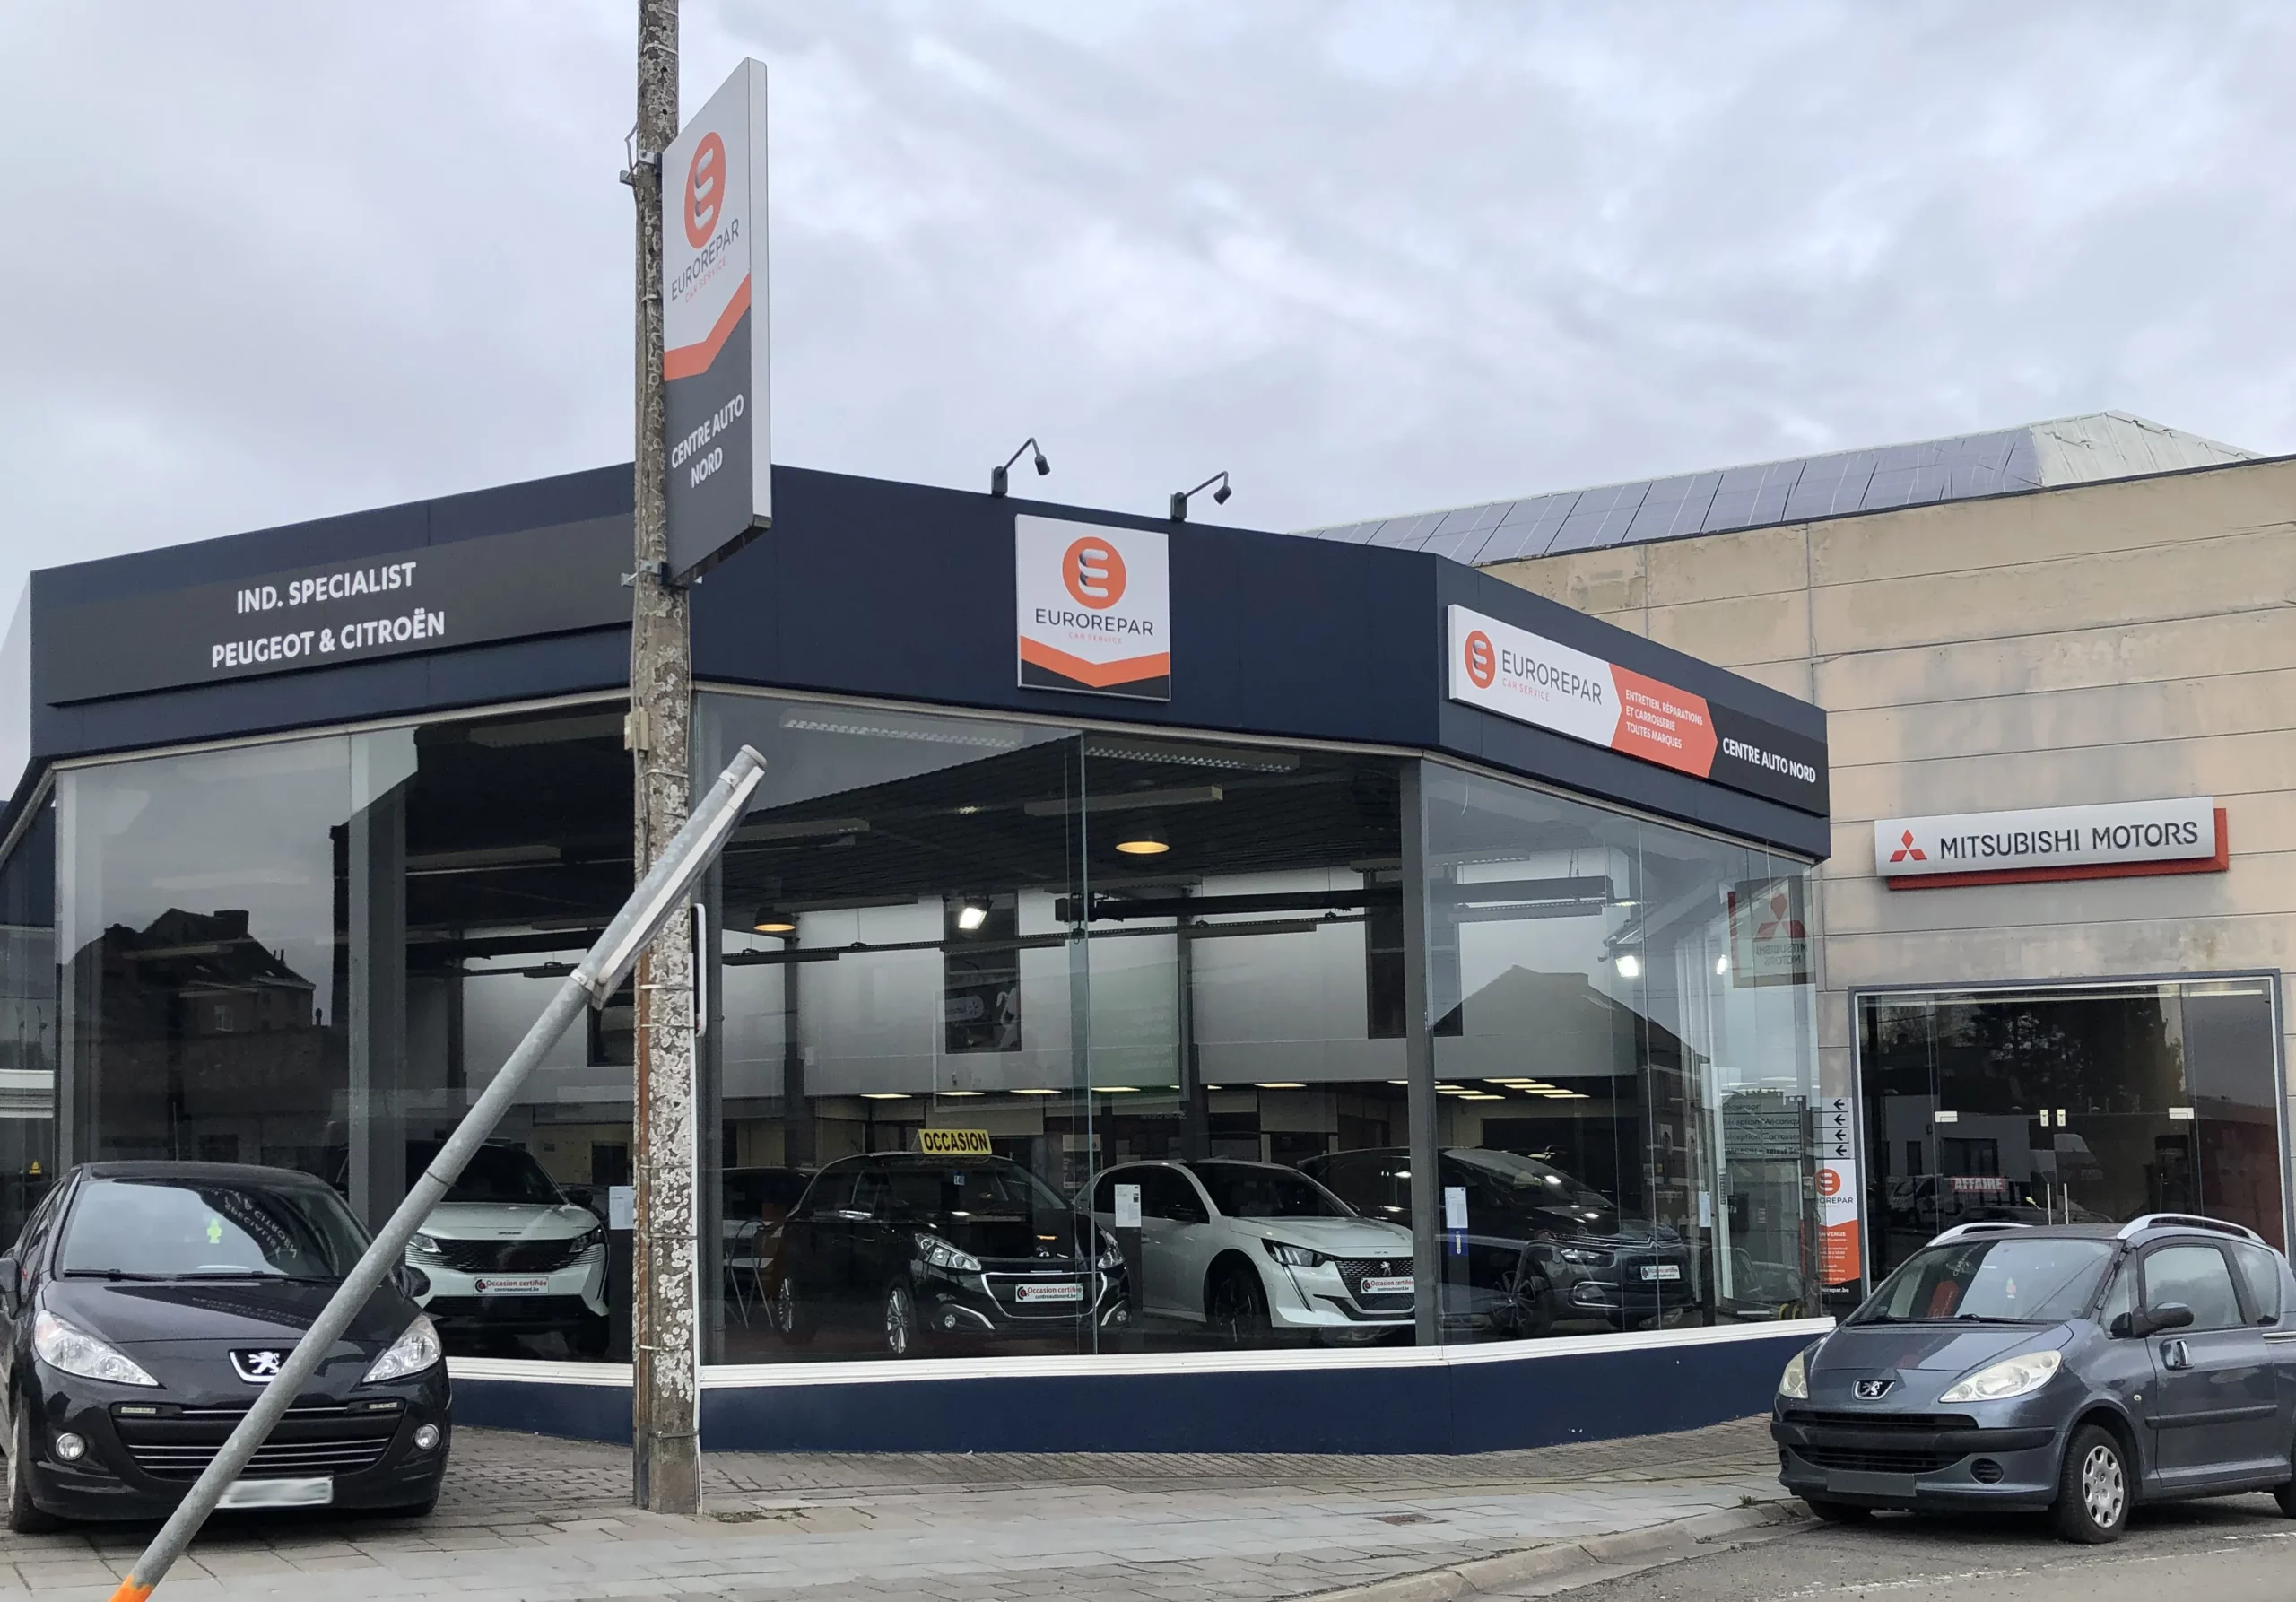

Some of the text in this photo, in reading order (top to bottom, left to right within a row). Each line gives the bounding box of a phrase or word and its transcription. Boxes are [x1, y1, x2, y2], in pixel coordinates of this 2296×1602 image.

[672, 218, 739, 302] EUROREPAR
[685, 256, 726, 303] CAR SERVICE
[672, 394, 744, 469] CENTRE AUTO
[691, 447, 723, 489] NORD
[238, 562, 416, 614] IND. SPECIALIST
[212, 607, 445, 668] PEUGEOT & CITROËN
[1035, 608, 1153, 637] EUROREPAR
[1068, 632, 1124, 645] CAR SERVICE
[1502, 649, 1602, 705] EUROREPAR
[1502, 678, 1550, 701] CAR SERVICE
[1625, 689, 1703, 726] ENTRETIEN, RÉPARATIONS
[1626, 706, 1675, 731] ET CARROSSERIE
[1626, 721, 1682, 749] TOUTES MARQUES
[1723, 737, 1816, 783] CENTRE AUTO NORD
[1941, 821, 2198, 859] MITSUBISHI MOTORS
[1761, 1118, 1800, 1127] Mécaniqu
[923, 1132, 989, 1152] OCCASION
[1955, 1177, 2004, 1190] AFFAIRE
[486, 1279, 517, 1287] Occasion
[1027, 1286, 1057, 1294] Occasion
